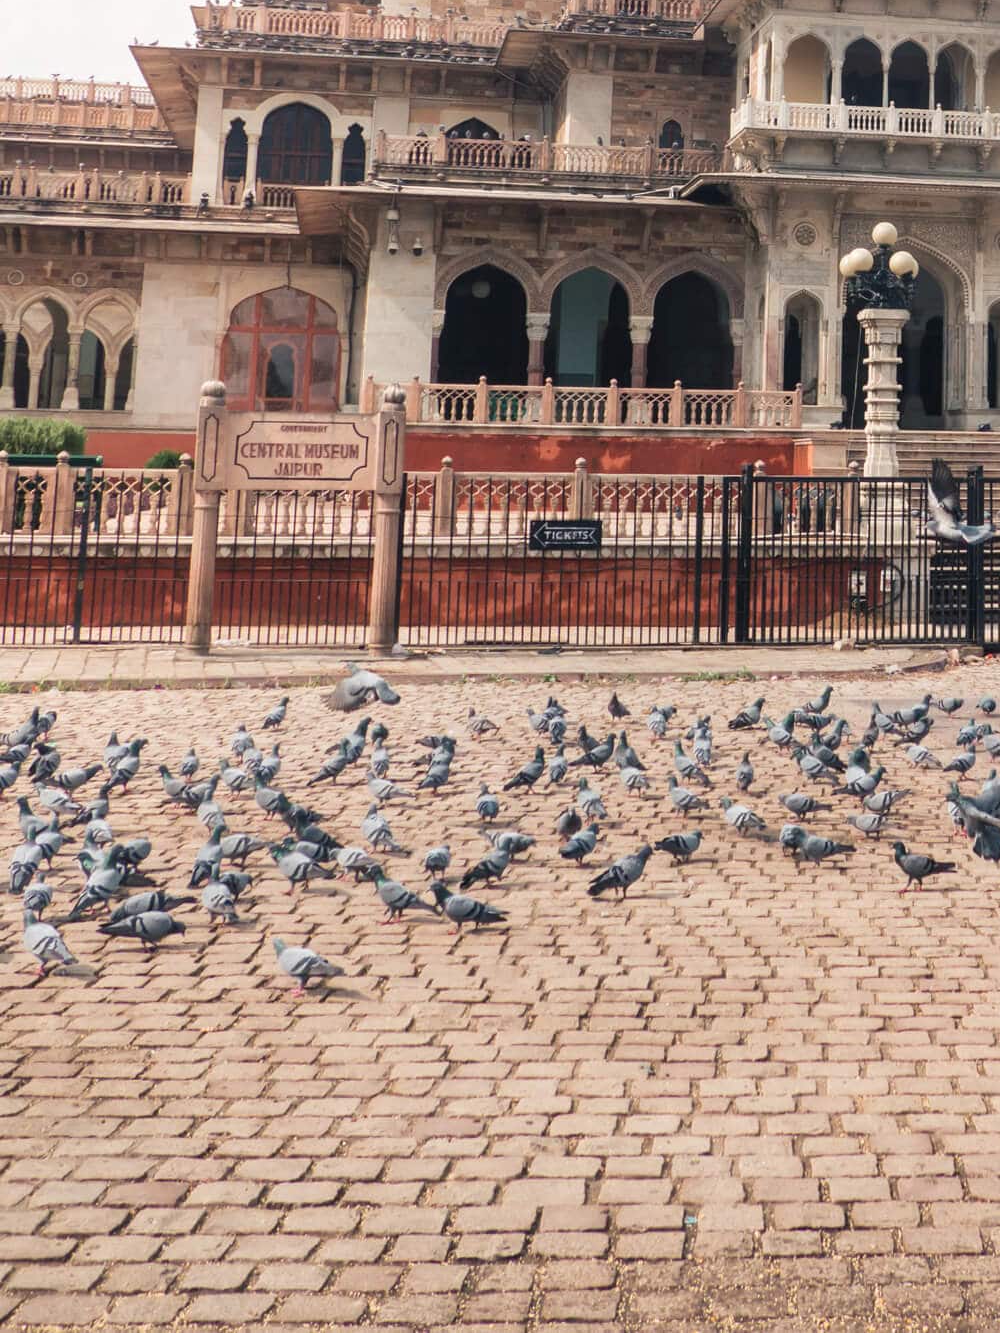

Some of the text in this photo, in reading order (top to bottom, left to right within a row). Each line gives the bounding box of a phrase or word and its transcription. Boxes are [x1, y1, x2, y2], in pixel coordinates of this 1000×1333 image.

[240, 442, 359, 459] CENTRAL MUSEUM
[274, 462, 323, 476] JAIPUR
[544, 530, 589, 540] TICKETS
